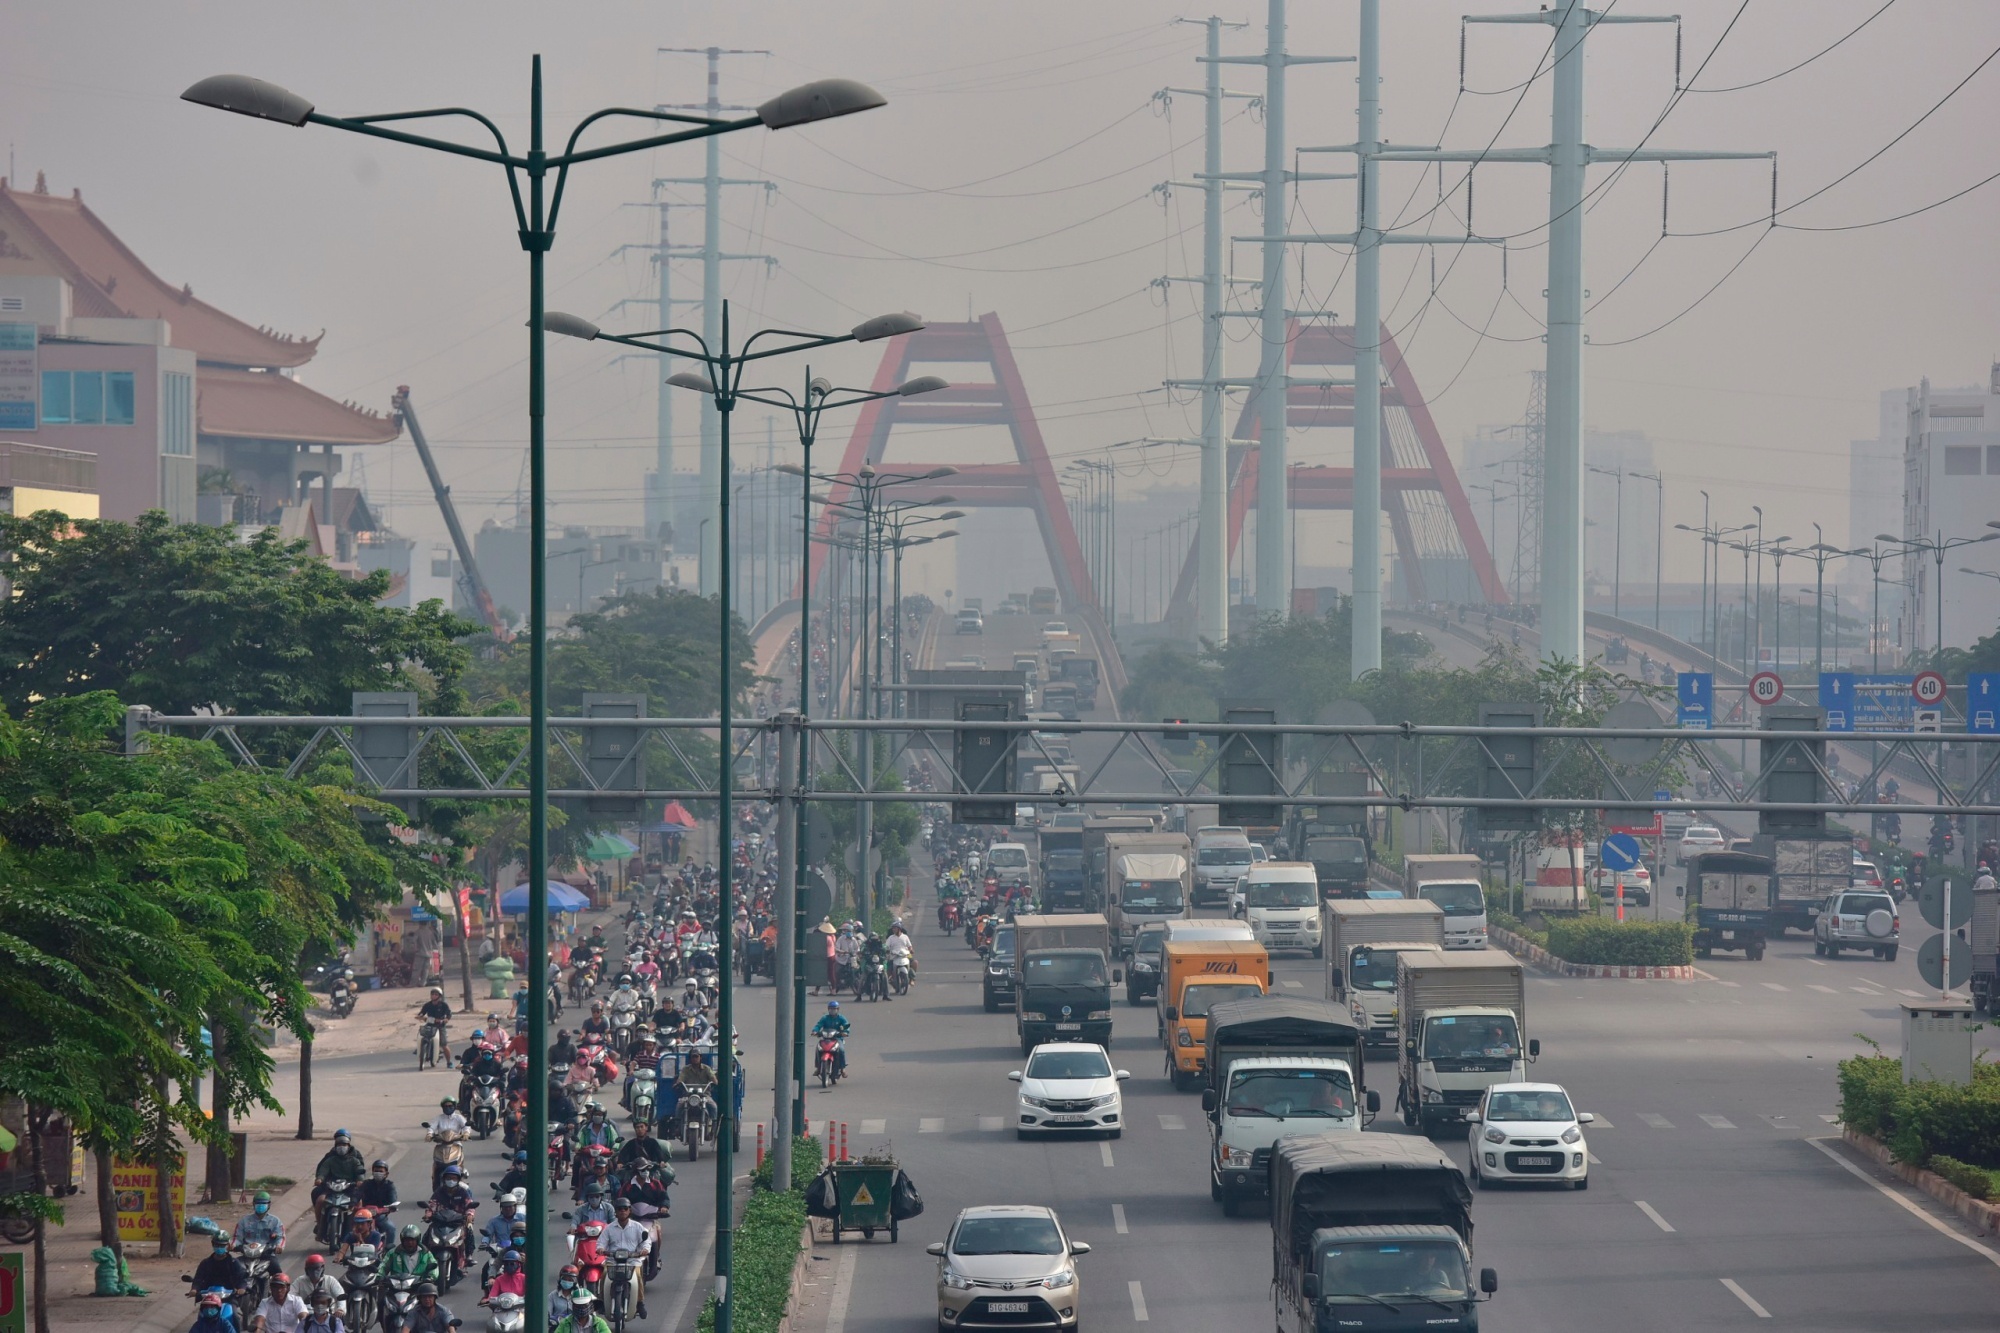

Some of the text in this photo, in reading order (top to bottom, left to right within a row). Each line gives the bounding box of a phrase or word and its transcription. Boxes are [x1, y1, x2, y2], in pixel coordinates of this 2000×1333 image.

[1758, 681, 1773, 695] 80
[1921, 680, 1936, 695] 60
[112, 1174, 152, 1187] CANH
